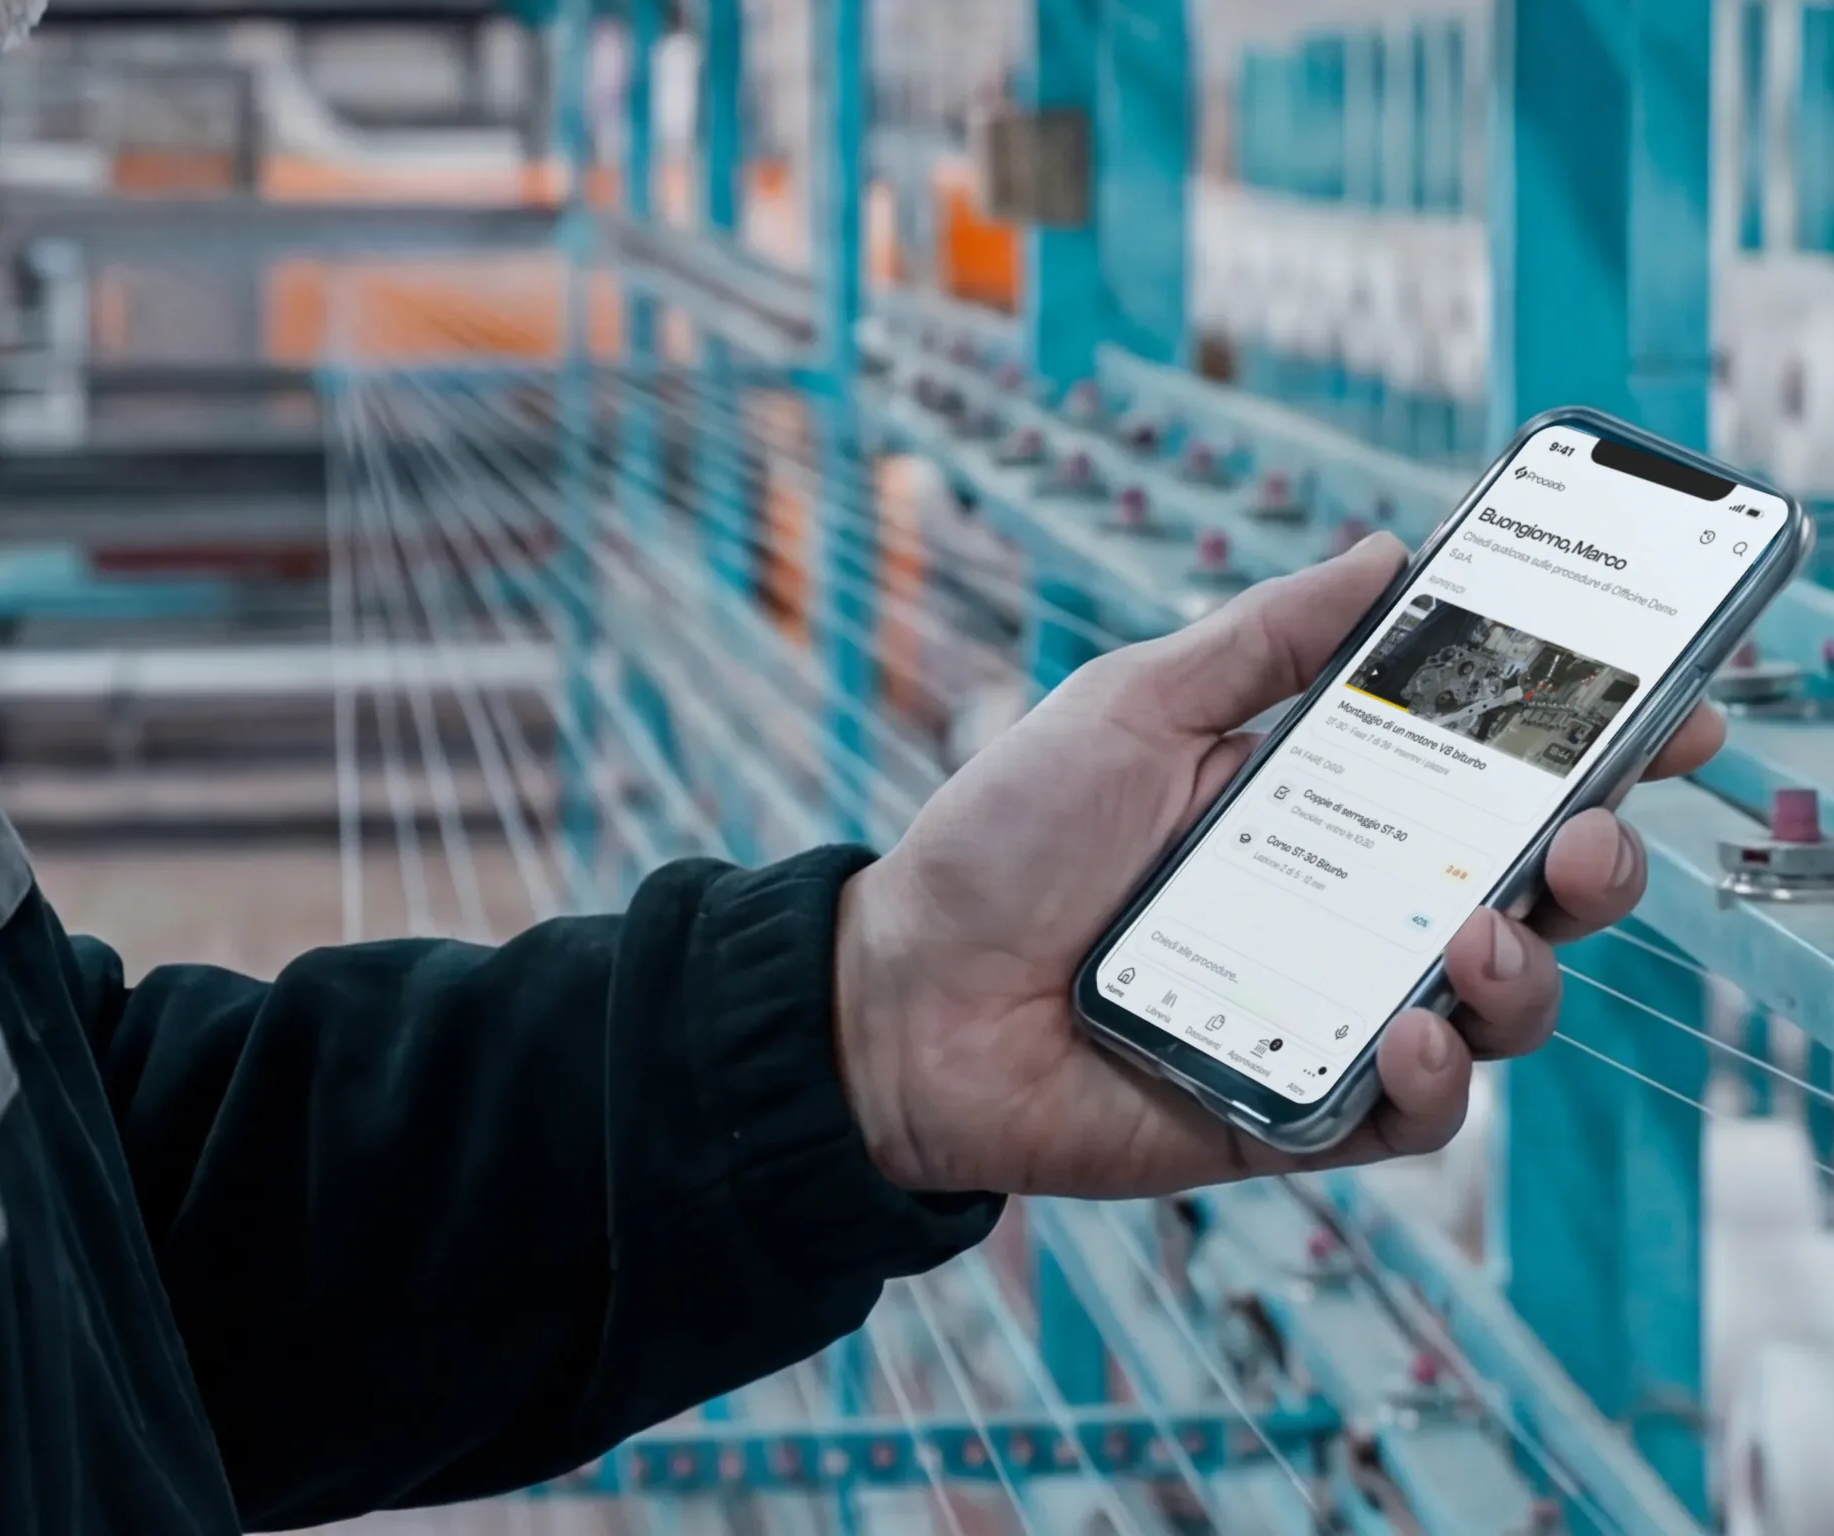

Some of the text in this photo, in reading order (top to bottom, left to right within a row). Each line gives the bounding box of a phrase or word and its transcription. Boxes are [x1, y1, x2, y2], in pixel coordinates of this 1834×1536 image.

[1549, 441, 1576, 457] 9:41
[1526, 471, 1566, 492] Procedo
[1478, 506, 1628, 571] Buongiorno, Marco
[1463, 531, 1678, 616] Chiedi qualcosa sulle procedure di Officine Demo
[1337, 700, 1487, 770] Montaggio di un motore V8 biturbo
[1303, 789, 1408, 842] Coppie di serraggio ST-30
[1266, 835, 1348, 879] Corso ST-30 Biturbo
[1151, 930, 1178, 951] Chiedi
[1176, 944, 1193, 959] alle
[1105, 982, 1125, 998] Home
[1185, 1026, 1222, 1051] Documenti
[1227, 1050, 1272, 1078] Approvazioni
[1286, 1082, 1306, 1096] Altro
